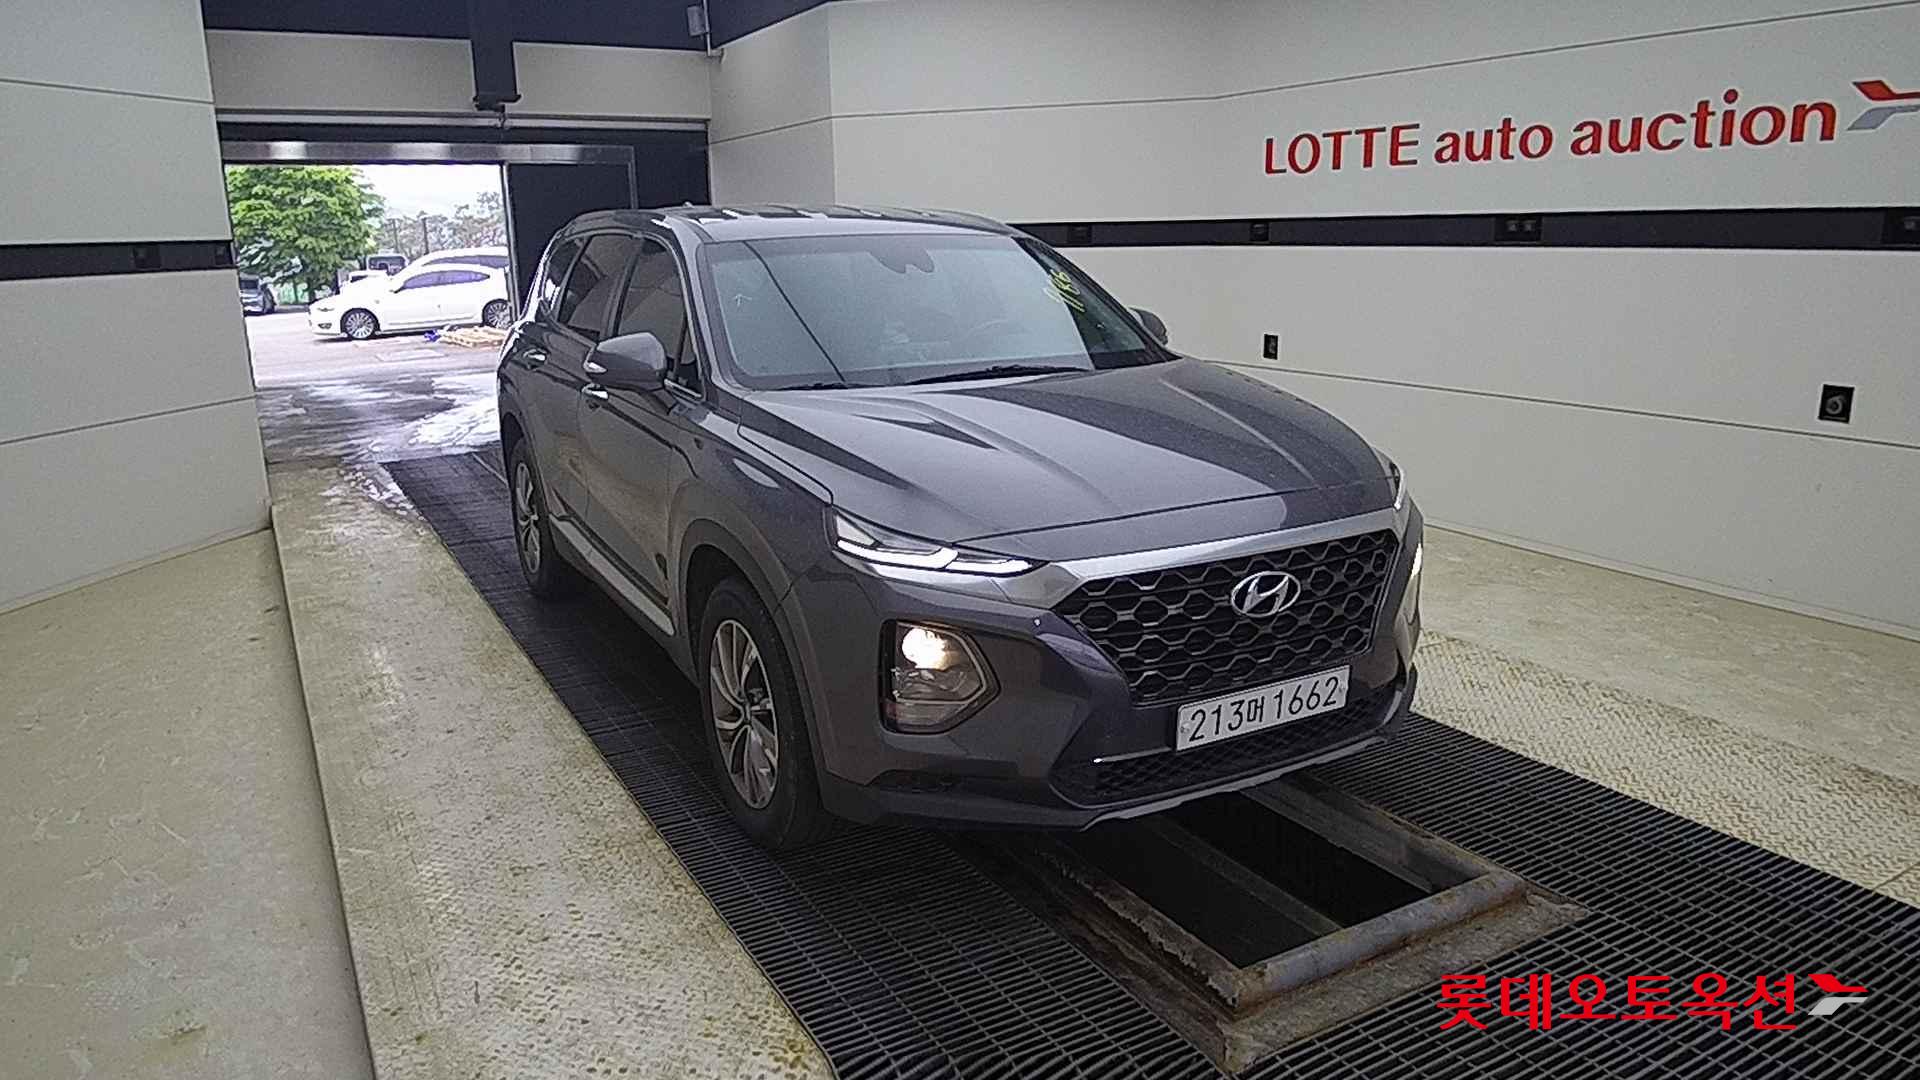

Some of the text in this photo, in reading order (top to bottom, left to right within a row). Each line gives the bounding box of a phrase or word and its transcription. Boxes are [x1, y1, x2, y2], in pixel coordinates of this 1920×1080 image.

[1265, 89, 1837, 175] LOTTE auto auction
[1188, 676, 1340, 743] 213머 1662
